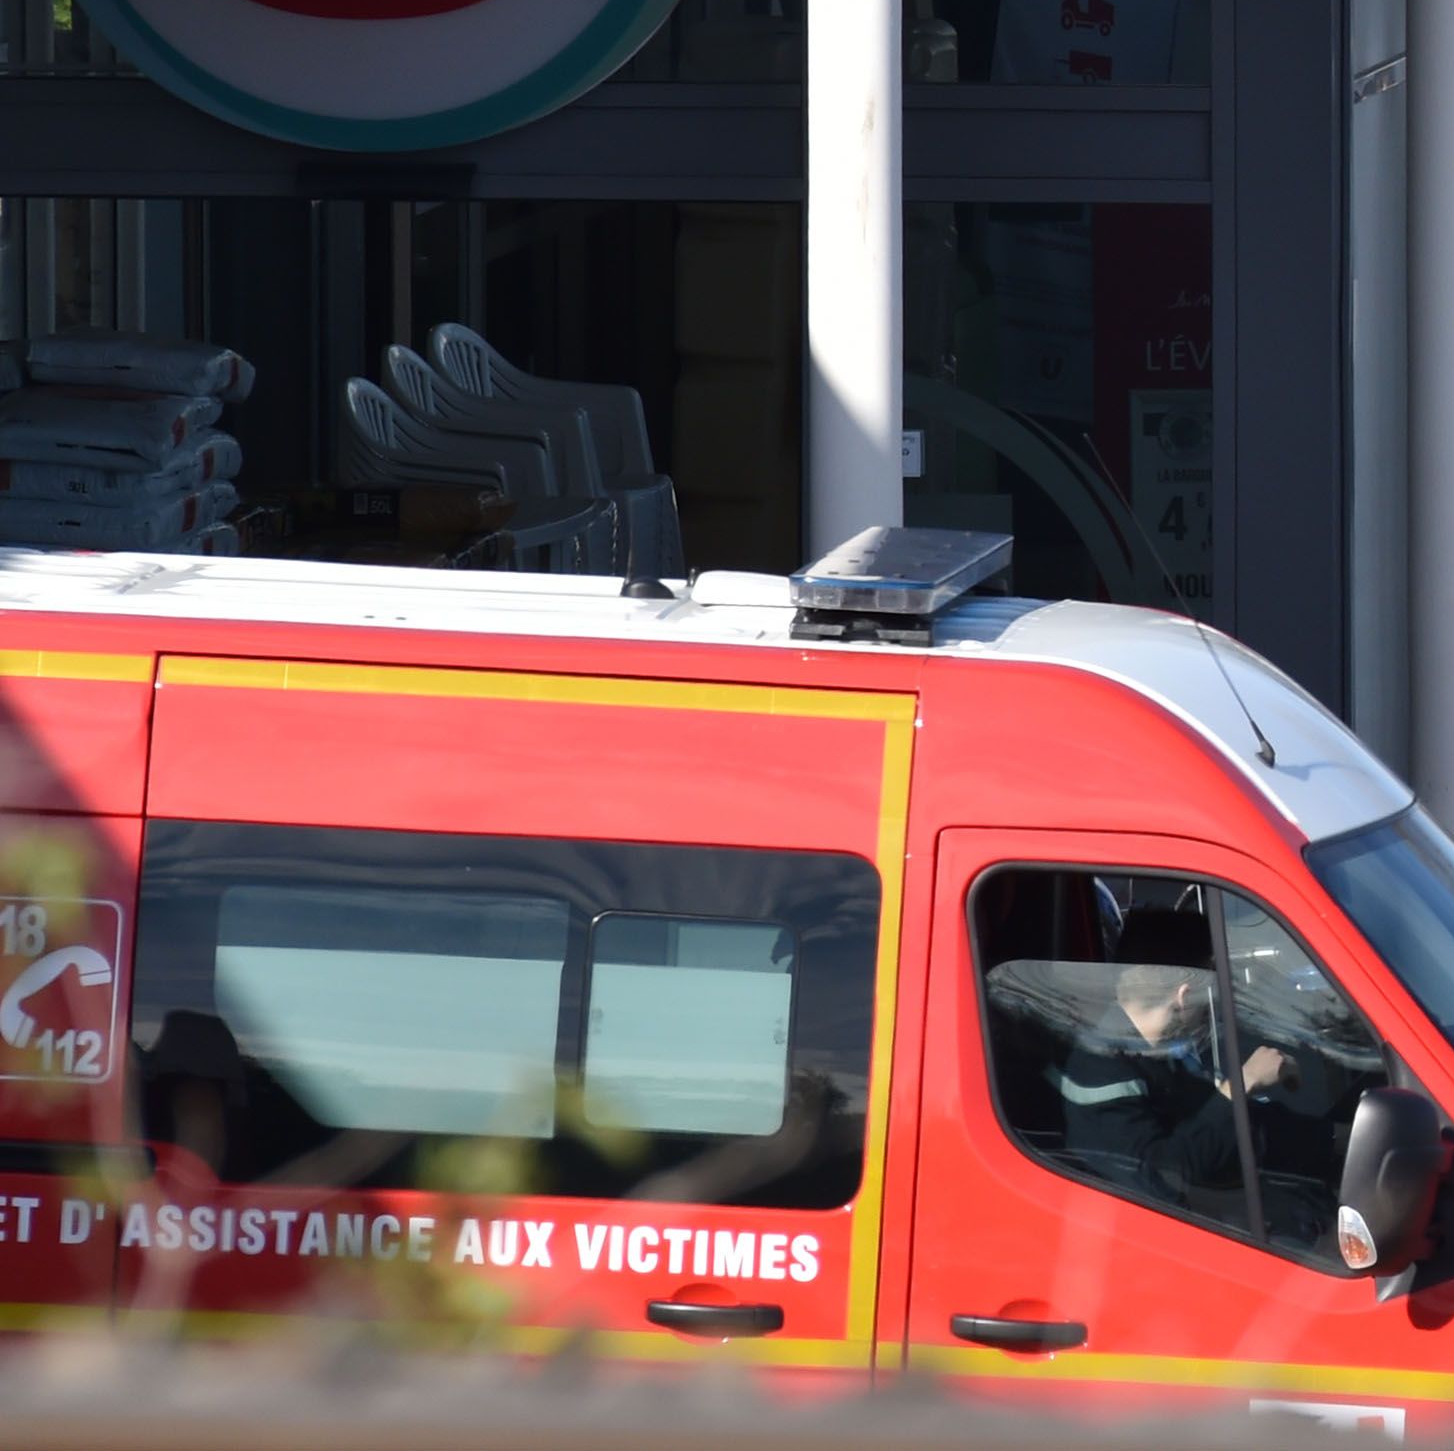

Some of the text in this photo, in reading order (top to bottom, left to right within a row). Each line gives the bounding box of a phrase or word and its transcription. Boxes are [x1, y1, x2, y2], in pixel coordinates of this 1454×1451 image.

[0, 903, 47, 957] 18
[36, 1028, 103, 1077] 112
[121, 1202, 436, 1263] ASSISTANCE
[454, 1218, 555, 1268] AUX
[573, 1223, 820, 1283] VICTIMES
